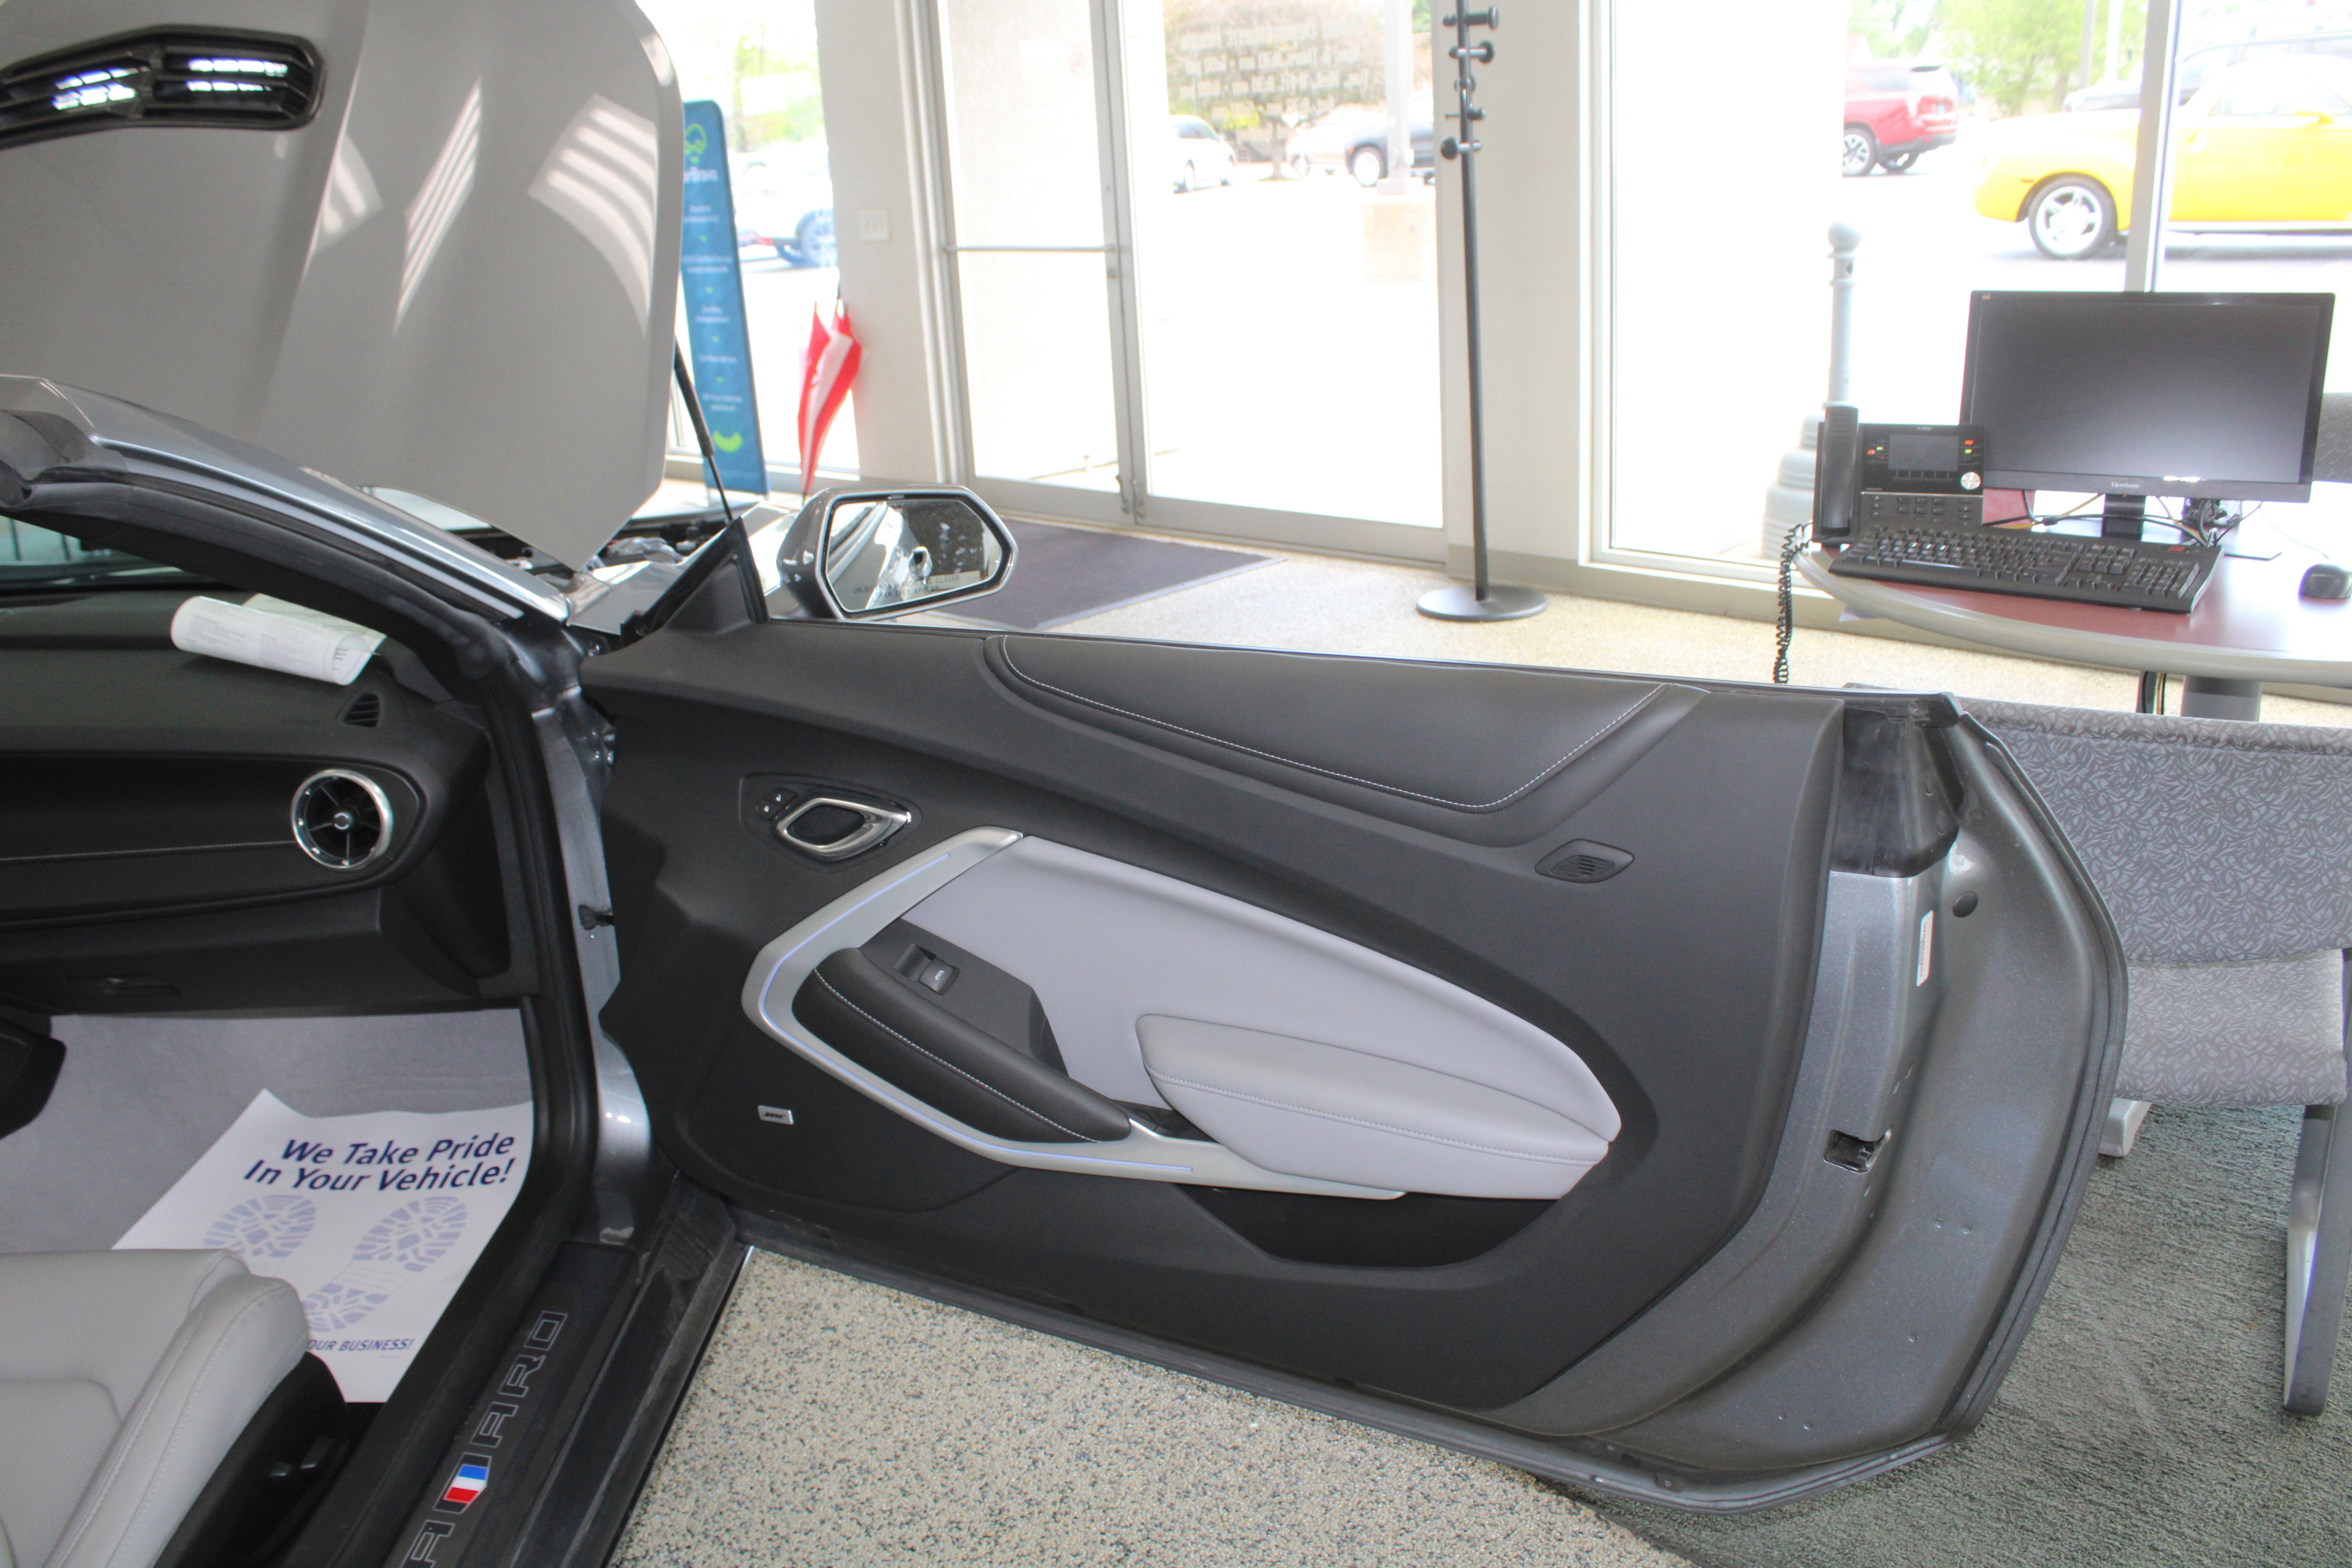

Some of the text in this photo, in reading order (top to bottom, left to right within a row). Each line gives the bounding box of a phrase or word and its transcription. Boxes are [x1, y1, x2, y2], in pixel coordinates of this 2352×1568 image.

[935, 575, 960, 583] CLOSER
[282, 1132, 515, 1165] We Take Pride
[243, 1158, 516, 1192] In Your Vehicle!
[307, 1339, 414, 1351] OUR BUSINESS!
